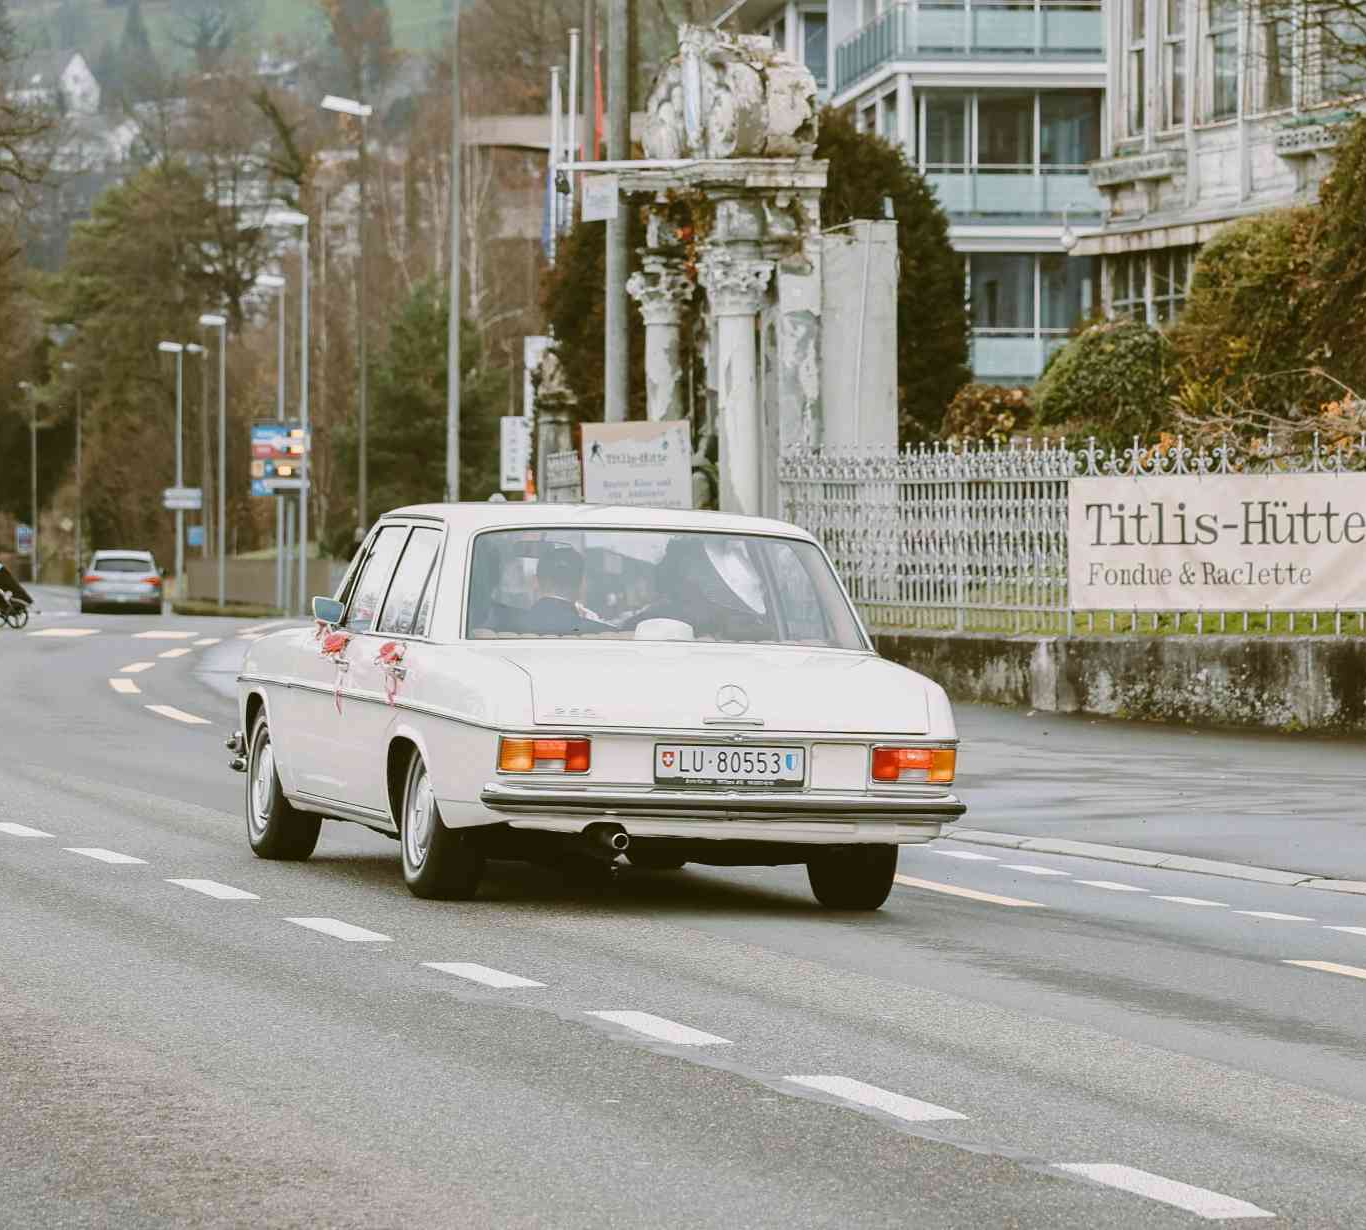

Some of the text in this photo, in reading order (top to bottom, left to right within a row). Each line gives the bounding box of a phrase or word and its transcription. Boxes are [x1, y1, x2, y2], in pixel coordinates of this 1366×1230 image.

[1086, 501, 1366, 546] Titlis-Hütte
[1087, 560, 1312, 587] Fondue & Raclette
